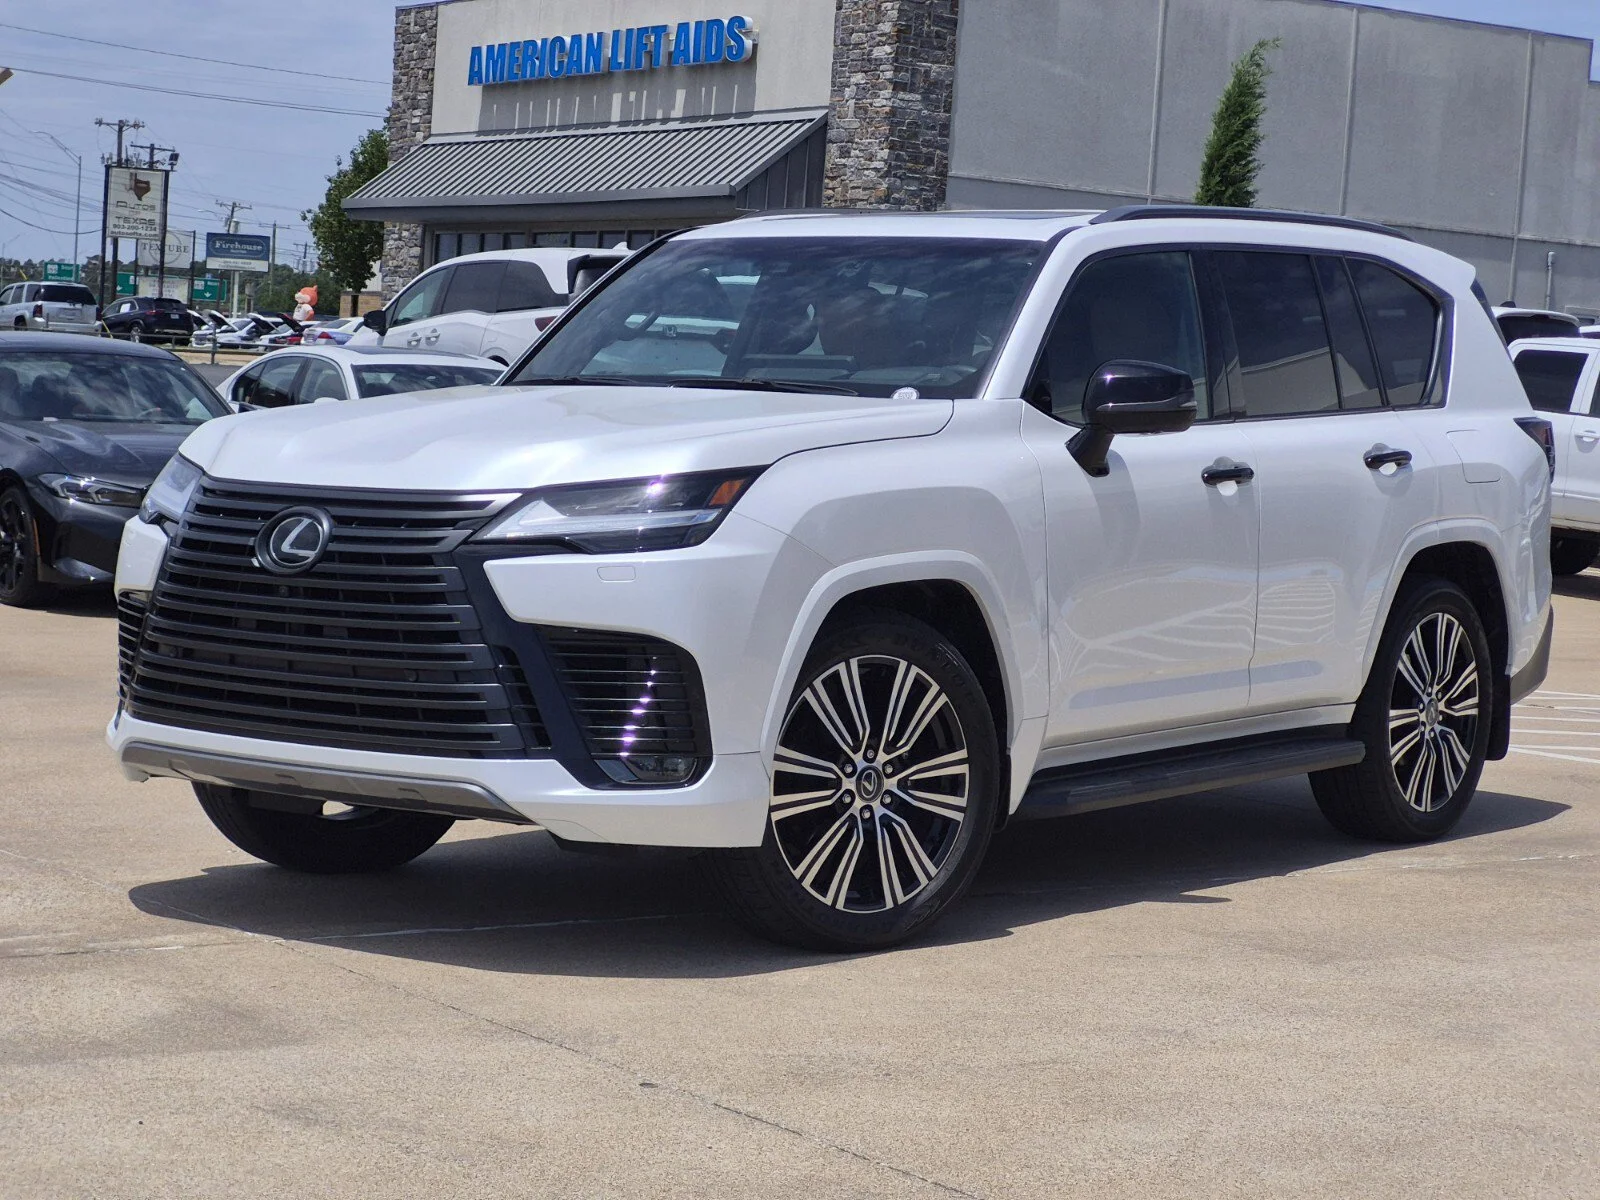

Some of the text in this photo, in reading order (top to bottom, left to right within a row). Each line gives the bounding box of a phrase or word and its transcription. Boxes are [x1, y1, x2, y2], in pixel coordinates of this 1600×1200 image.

[467, 15, 753, 86] AMERICAN LIFT AIDS
[115, 215, 156, 226] TEXAS
[142, 243, 189, 254] TEXURE
[215, 240, 263, 251] Firehouse
